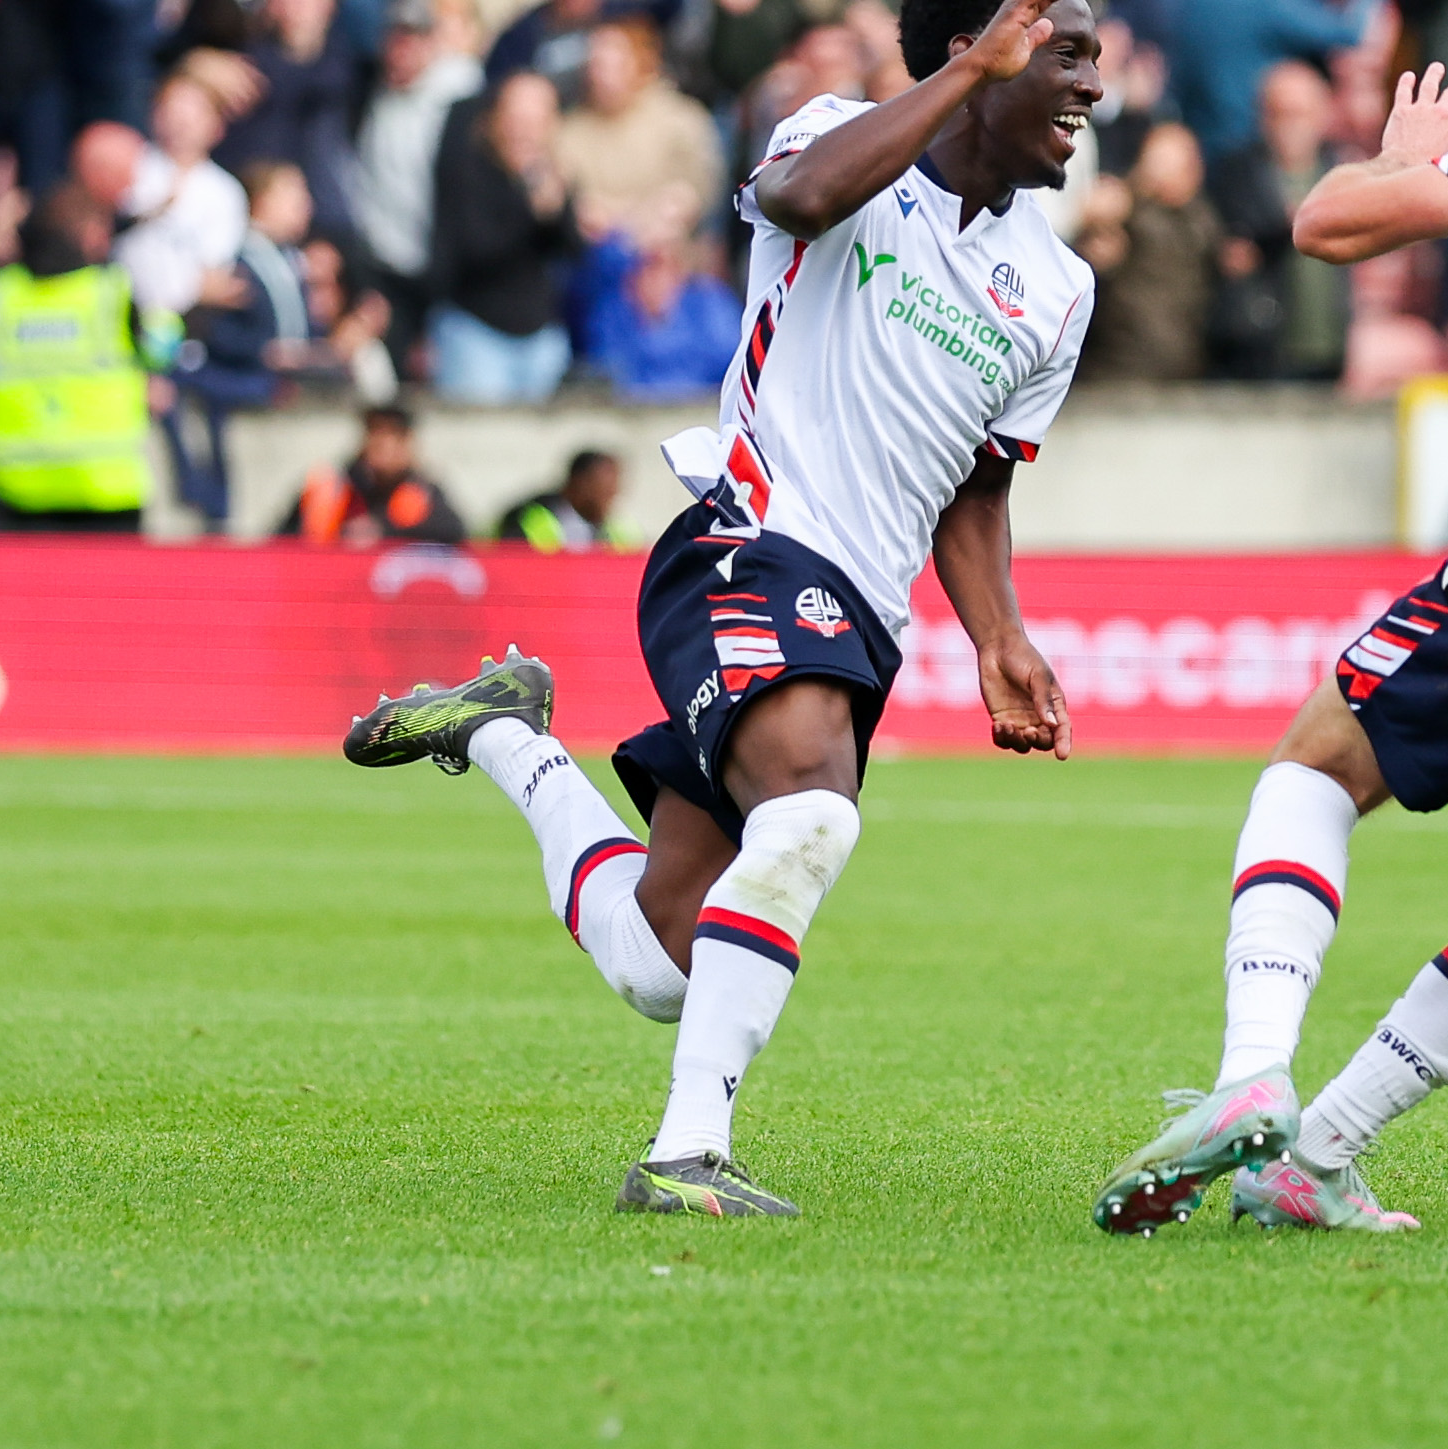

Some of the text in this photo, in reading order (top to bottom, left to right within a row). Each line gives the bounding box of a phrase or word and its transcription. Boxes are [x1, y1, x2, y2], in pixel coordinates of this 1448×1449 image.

[901, 271, 1013, 356] victorian
[522, 755, 570, 808] BWFC
[1377, 1029, 1434, 1082] BWFC
